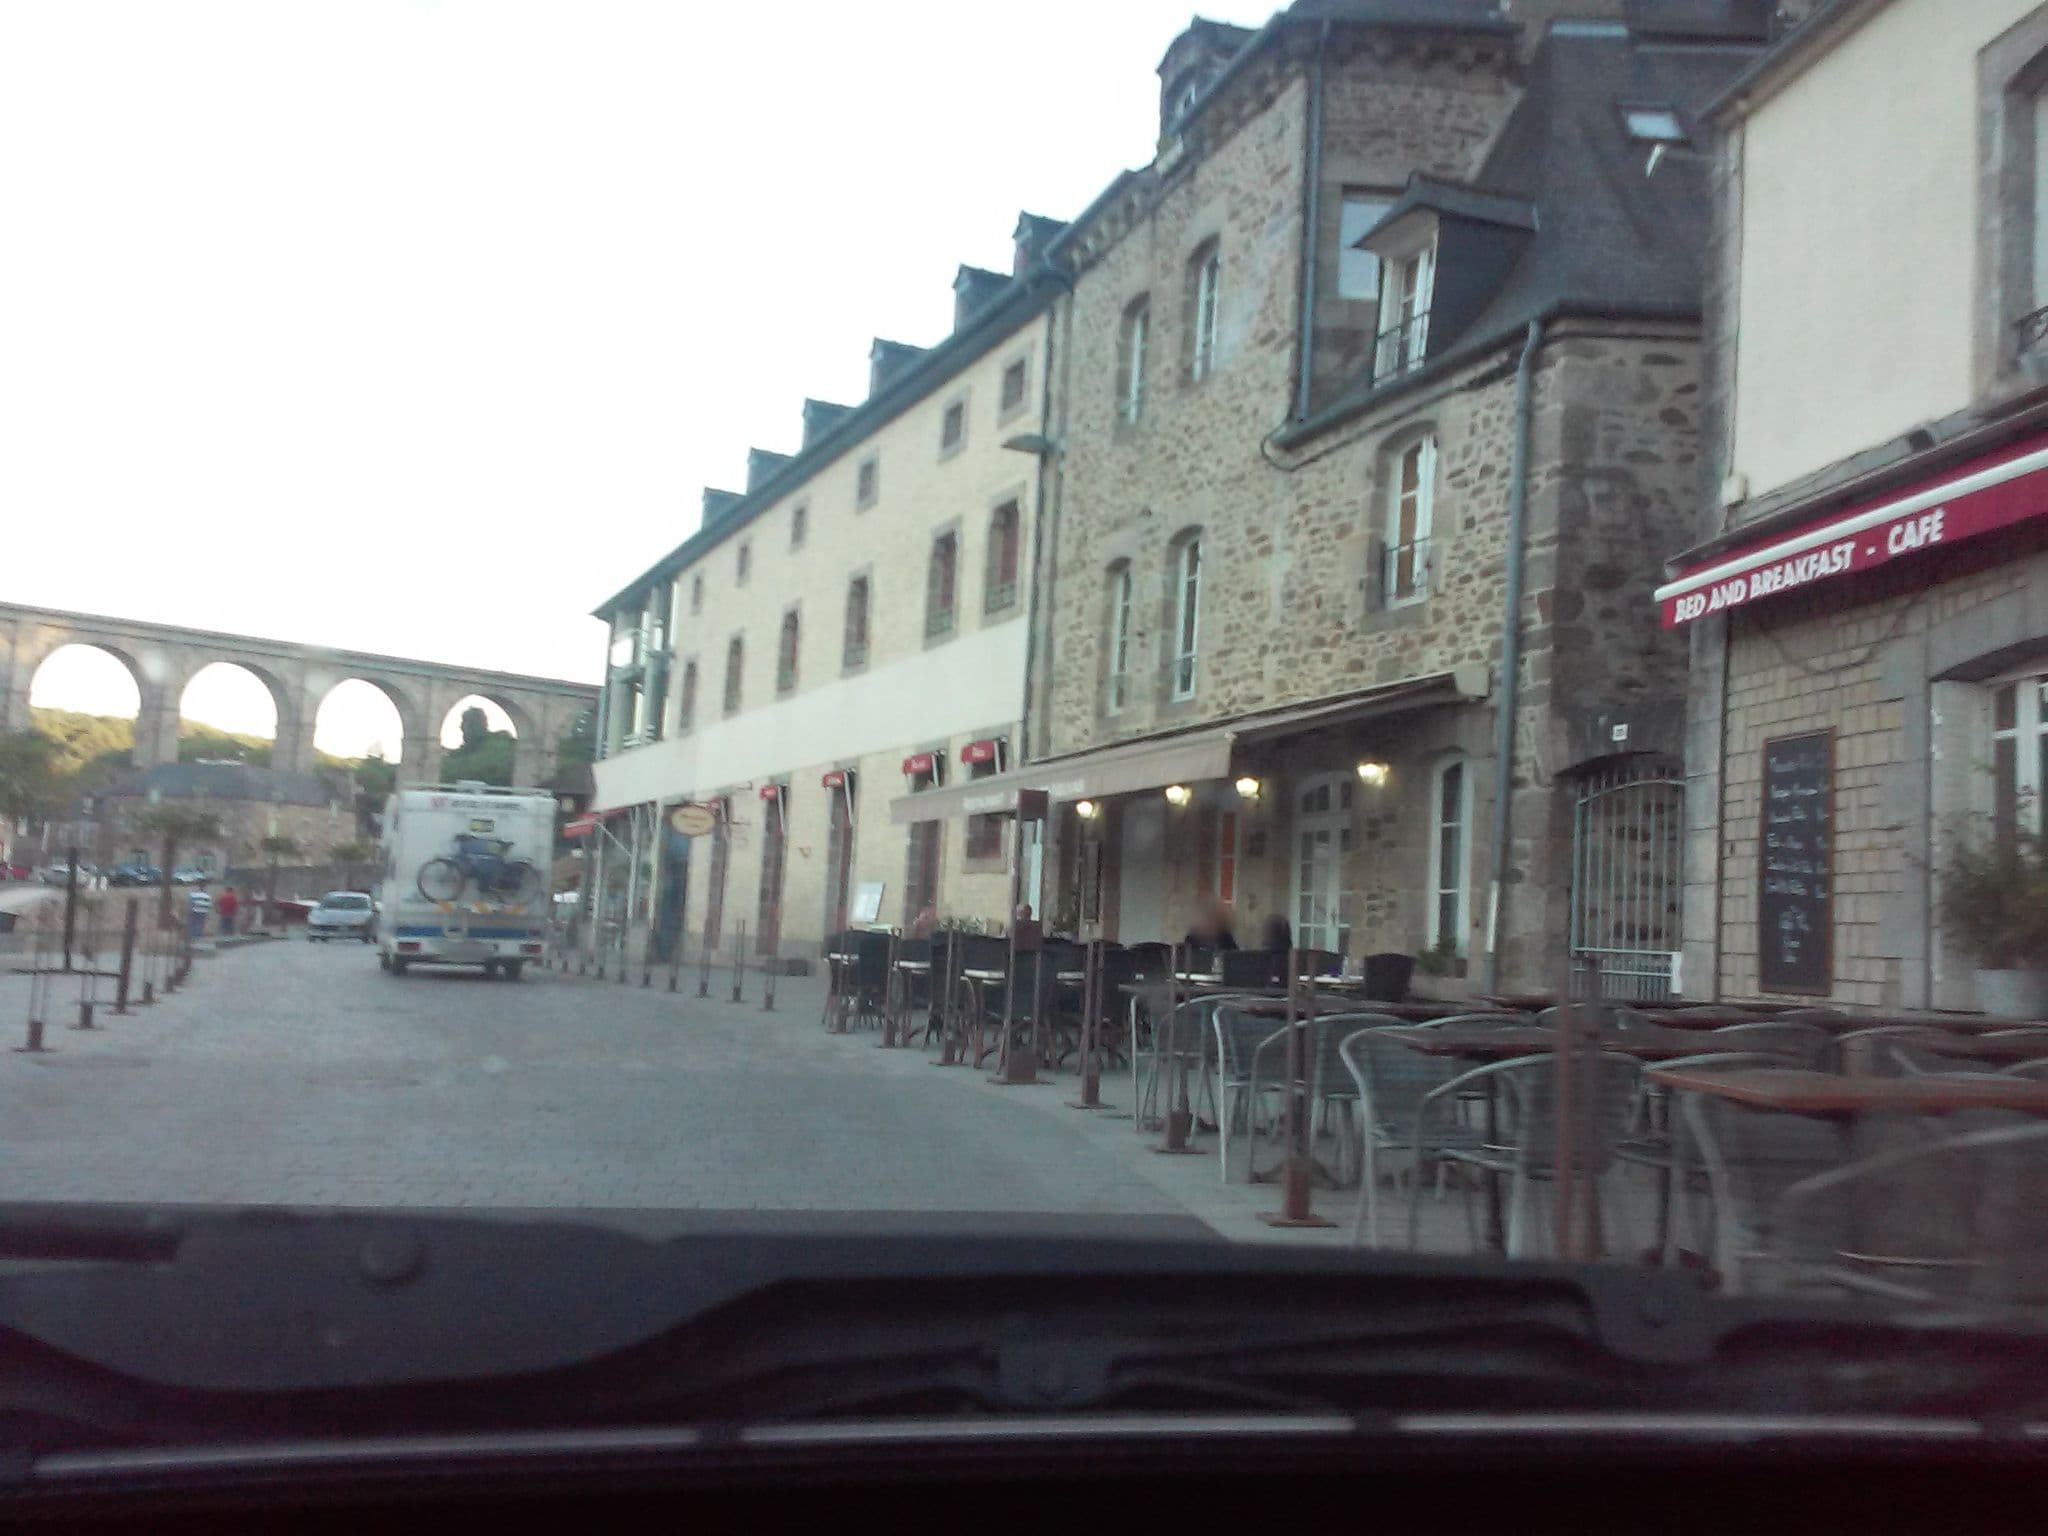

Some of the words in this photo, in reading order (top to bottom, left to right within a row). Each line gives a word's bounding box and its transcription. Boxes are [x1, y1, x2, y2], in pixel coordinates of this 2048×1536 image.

[1674, 593, 1706, 623] BED
[1707, 579, 1748, 612] AND
[1750, 541, 1856, 599] BREAKFAST
